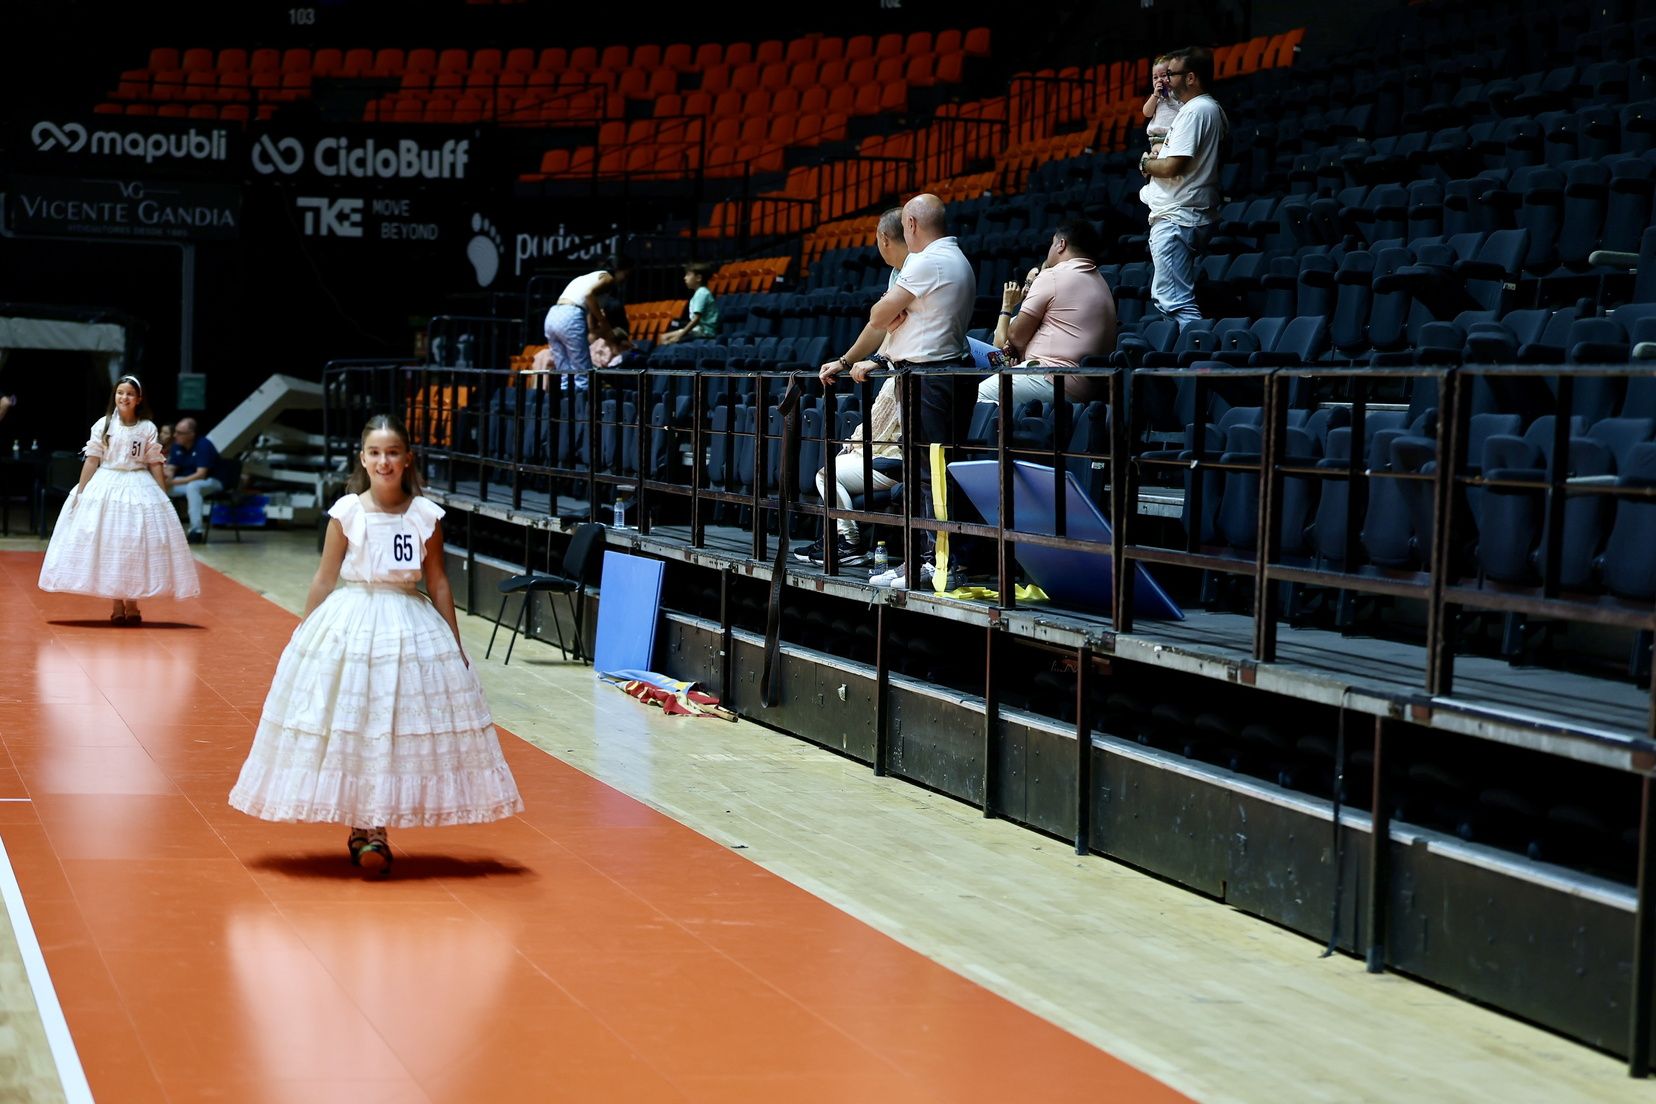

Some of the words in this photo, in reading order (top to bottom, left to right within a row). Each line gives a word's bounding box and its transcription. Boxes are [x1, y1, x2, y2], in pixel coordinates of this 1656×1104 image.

[289, 8, 315, 25] 103
[91, 129, 227, 163] mapubli
[314, 137, 469, 179] CicloBuff
[20, 194, 128, 222] VICENTE
[137, 200, 235, 227] GANDIA
[297, 197, 363, 237] TKE
[372, 199, 411, 216] MOVE
[381, 222, 439, 240] BEYOND
[131, 441, 141, 457] 51
[393, 533, 413, 562] 65
